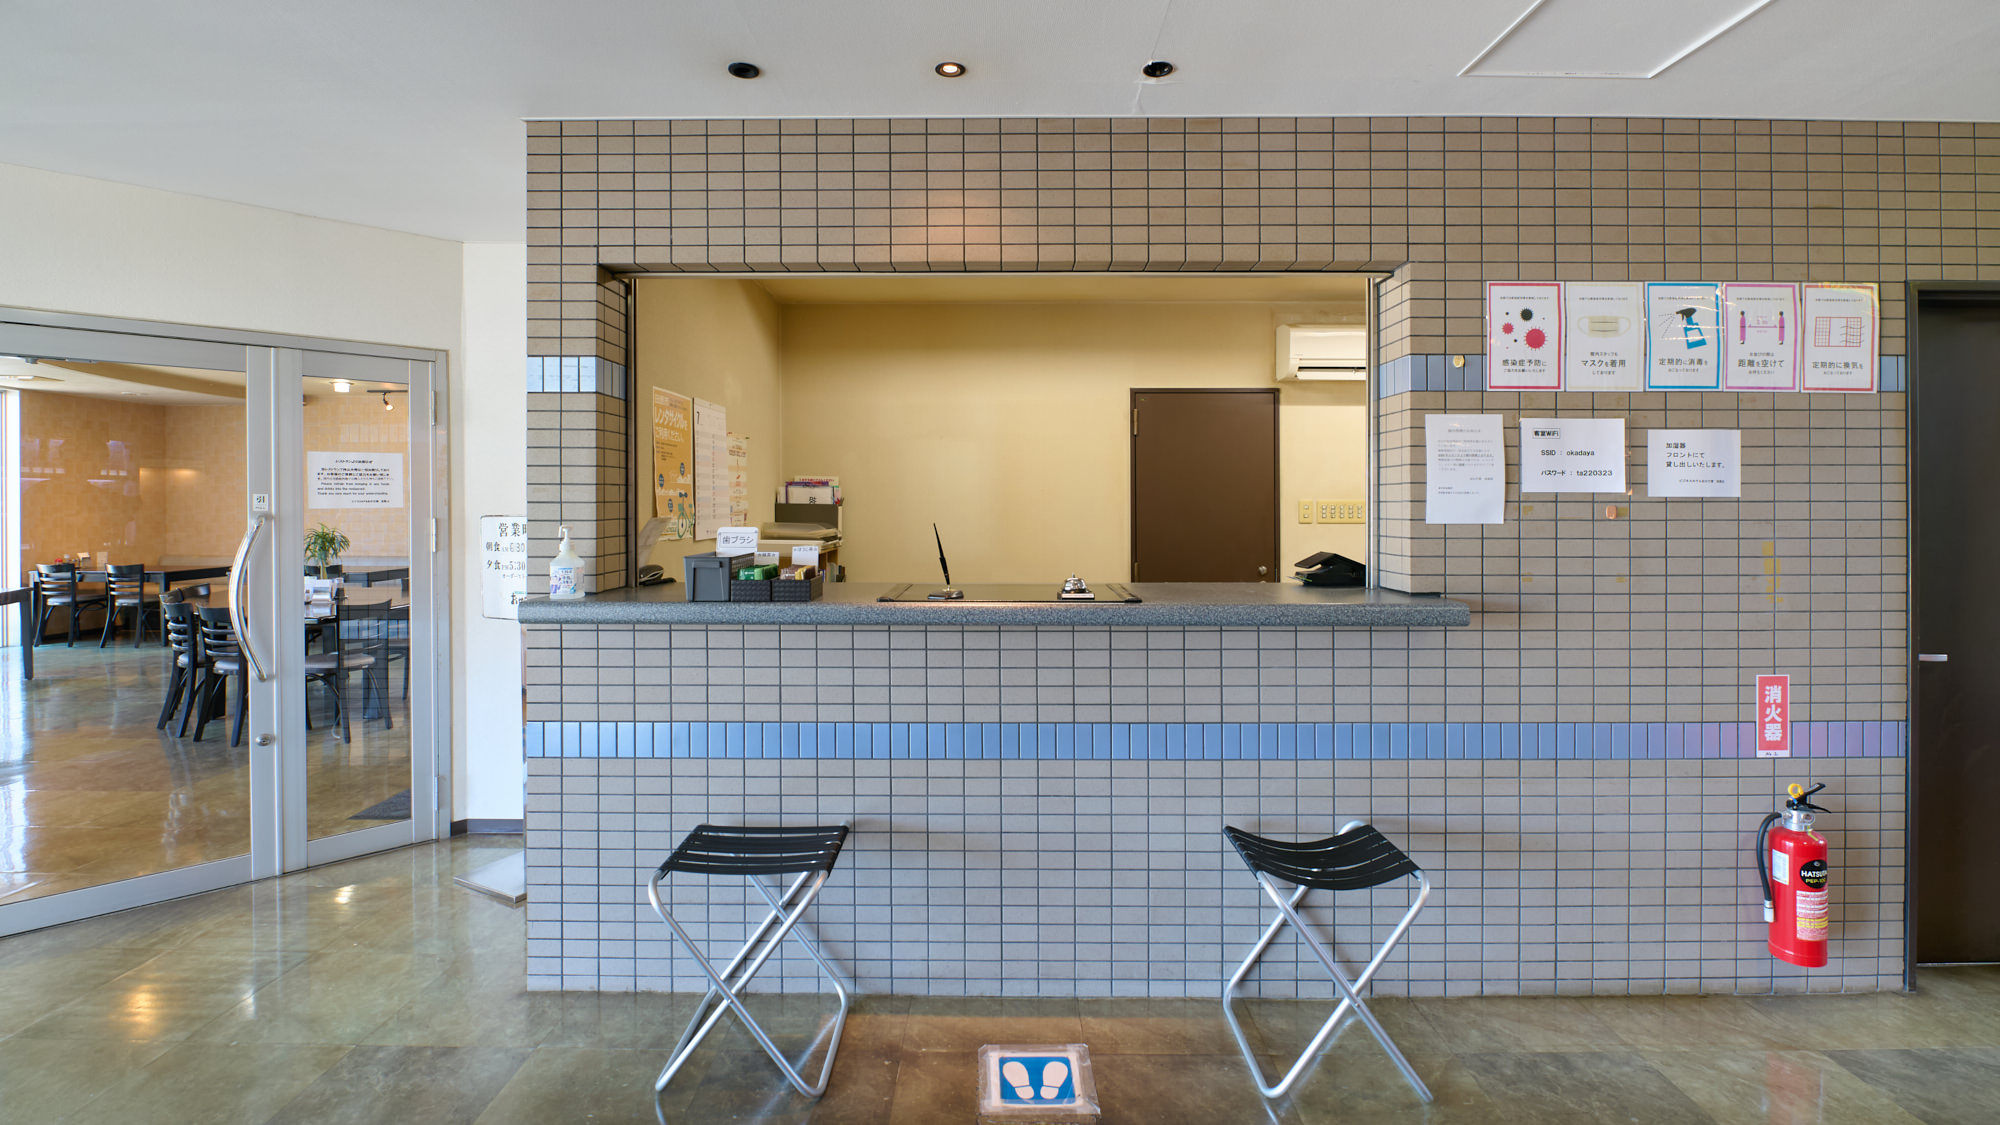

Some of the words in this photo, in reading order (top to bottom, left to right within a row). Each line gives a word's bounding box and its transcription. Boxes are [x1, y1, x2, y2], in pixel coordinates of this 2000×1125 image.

[1502, 358, 1547, 367] 感染症予防に
[1581, 359, 1626, 368] マスクを着用
[1658, 357, 1708, 366] 定期的に消毒を
[1738, 359, 1785, 368] 距離を空けて
[1811, 361, 1864, 369] 定期的に換気を
[1566, 449, 1595, 457] okadaya
[1665, 461, 1725, 469] 貸し出しいたします。
[1541, 469, 1566, 477] パスワード
[1576, 469, 1613, 477] ta220323
[255, 495, 265, 504] 引
[722, 535, 754, 545] 歯ブラシ
[1764, 684, 1783, 742] 消火器
